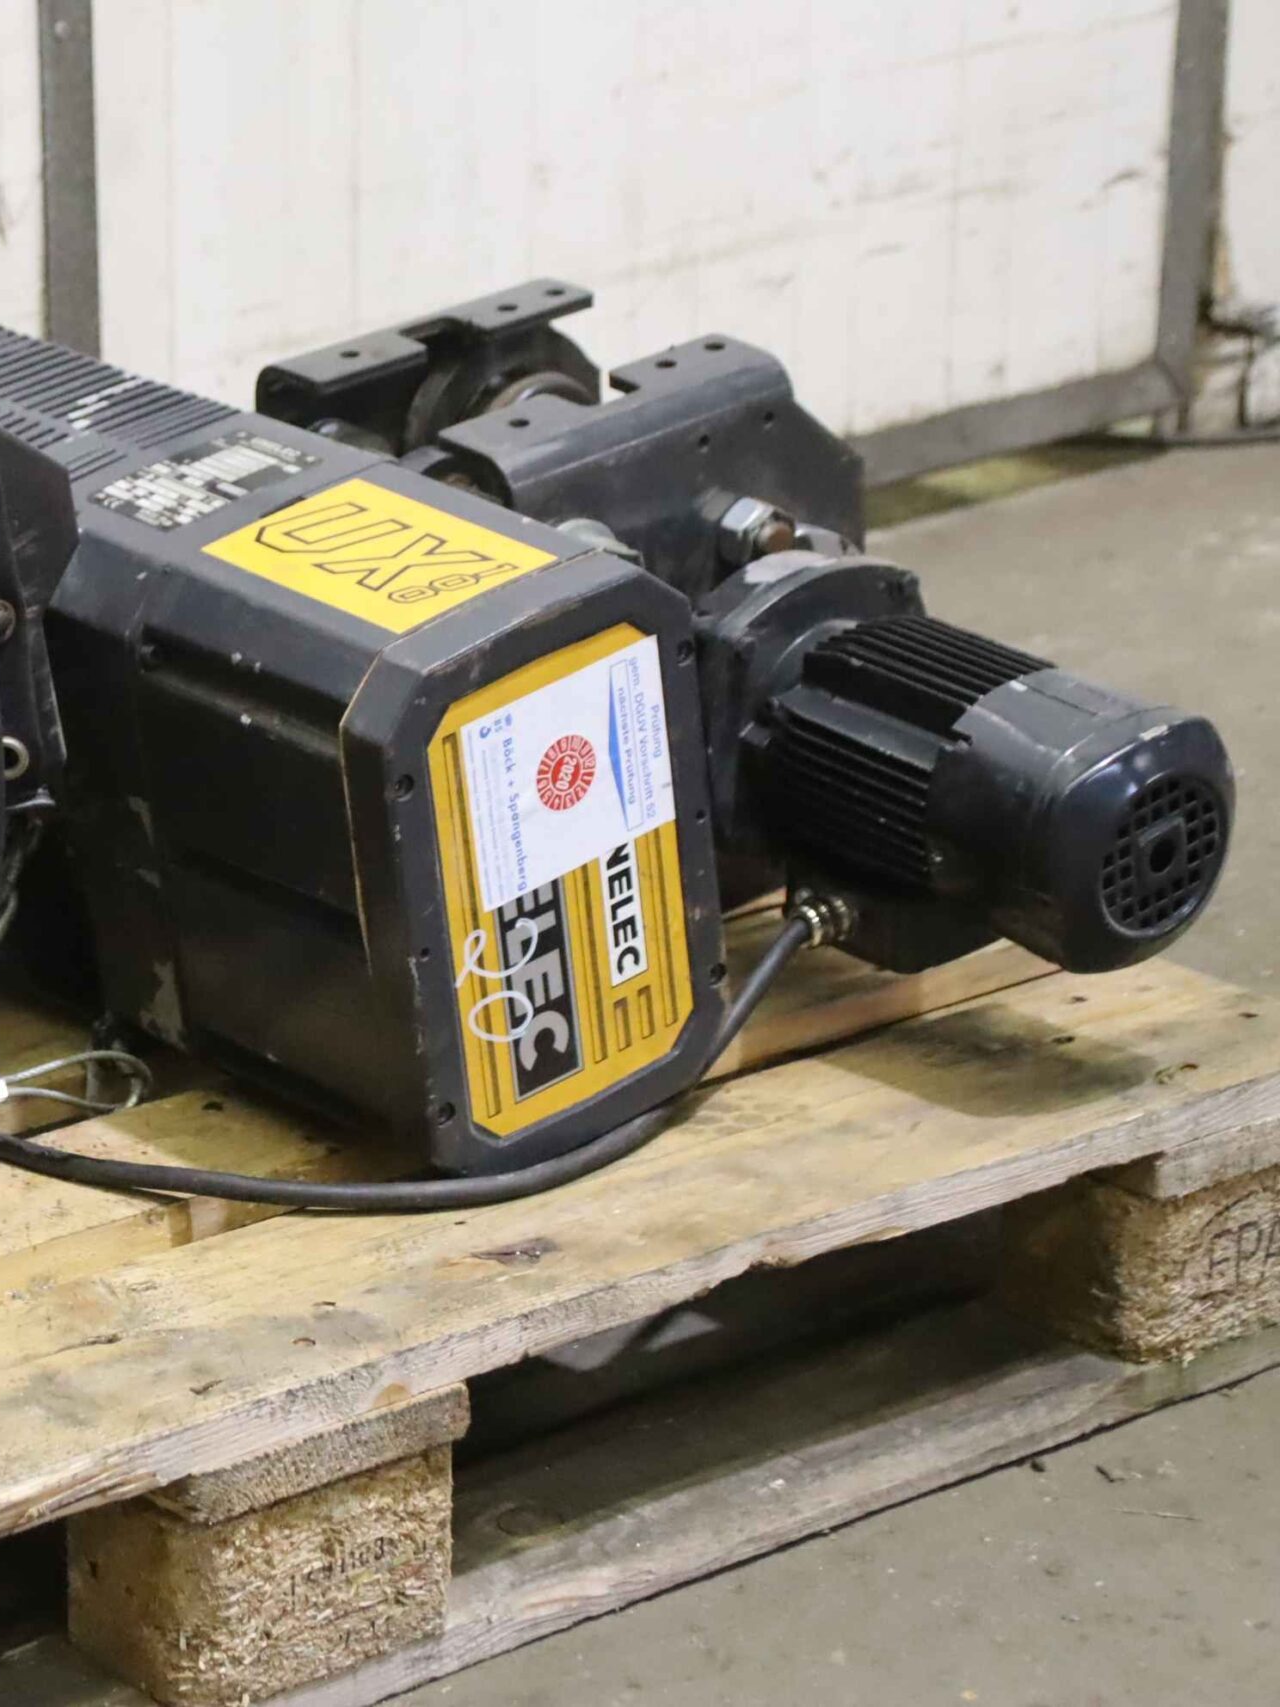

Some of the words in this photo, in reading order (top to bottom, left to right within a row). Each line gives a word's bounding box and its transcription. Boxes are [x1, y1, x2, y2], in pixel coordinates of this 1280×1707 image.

[502, 737, 517, 774] Böck
[554, 754, 578, 791] 2020
[507, 792, 528, 892] Spangenberg
